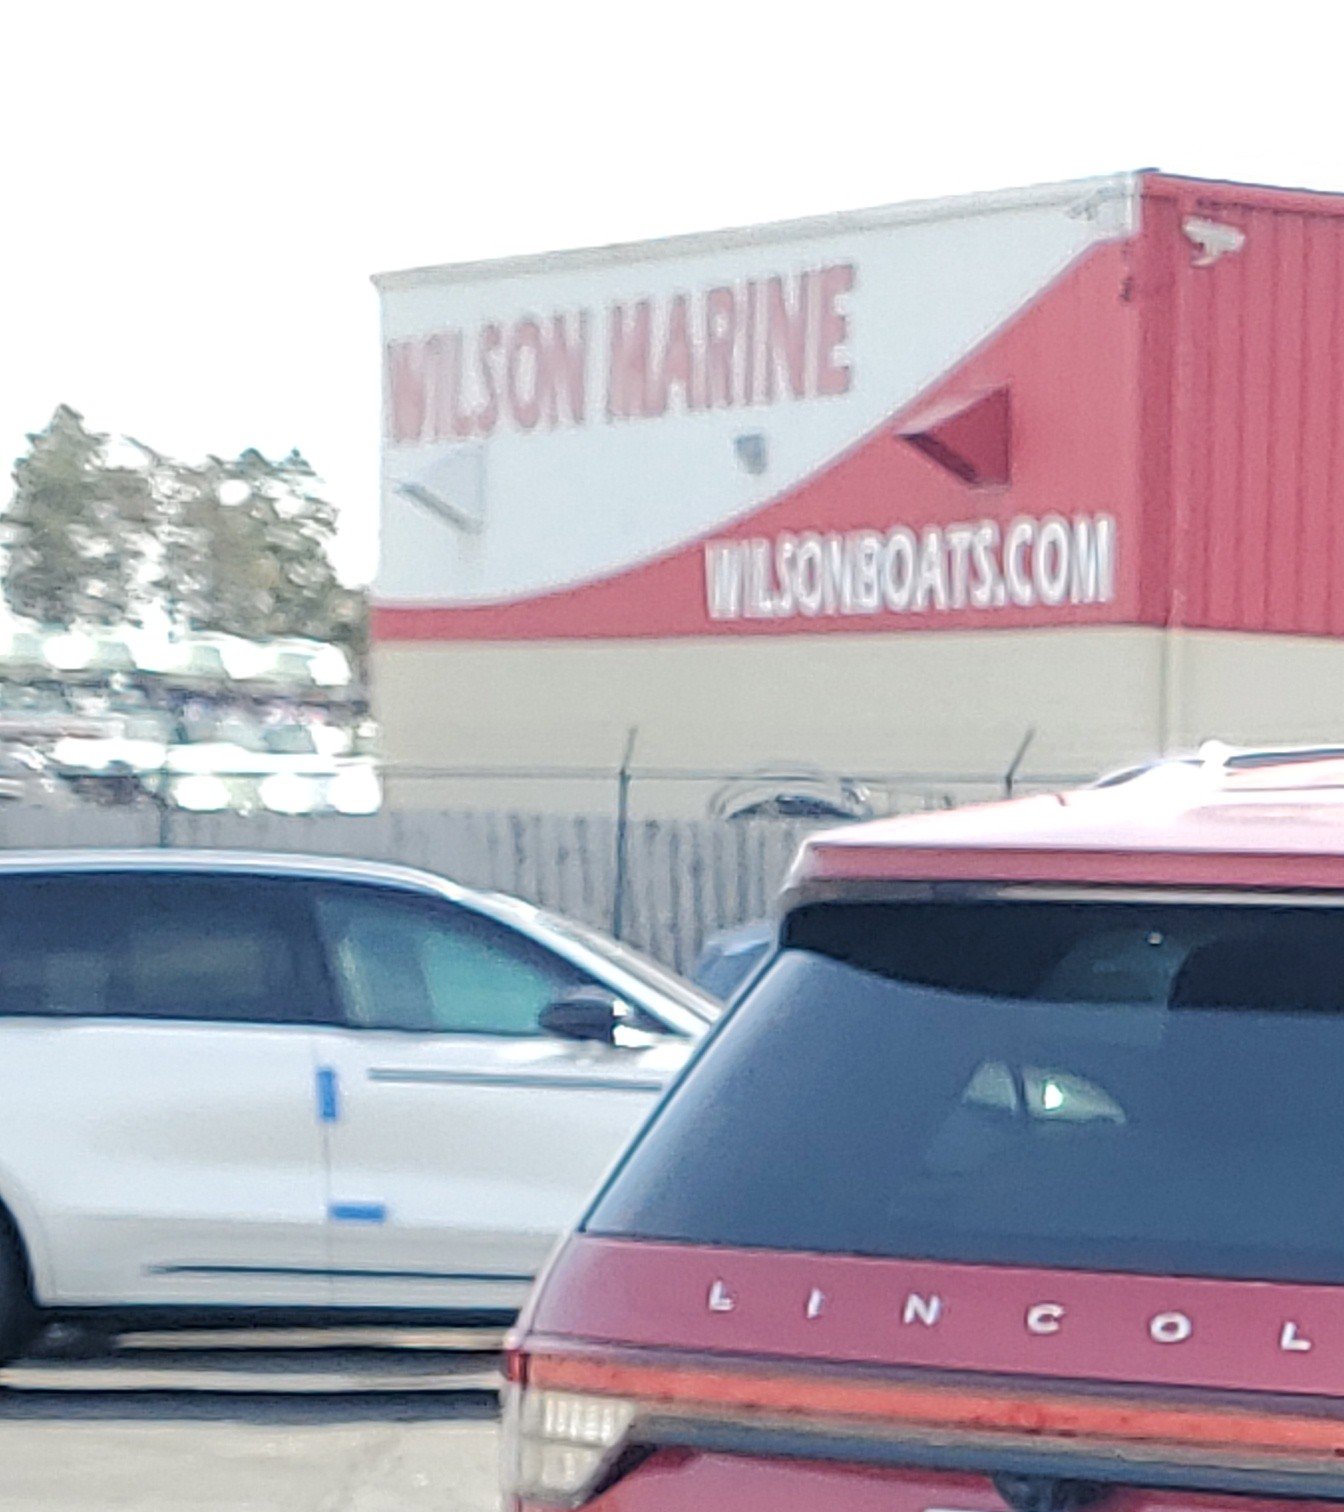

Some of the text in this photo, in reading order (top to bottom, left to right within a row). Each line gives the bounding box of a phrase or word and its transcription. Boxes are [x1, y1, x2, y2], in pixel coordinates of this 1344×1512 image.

[386, 263, 855, 444] WILSON MARINE
[705, 512, 1116, 621] WILSONBOATS.COM
